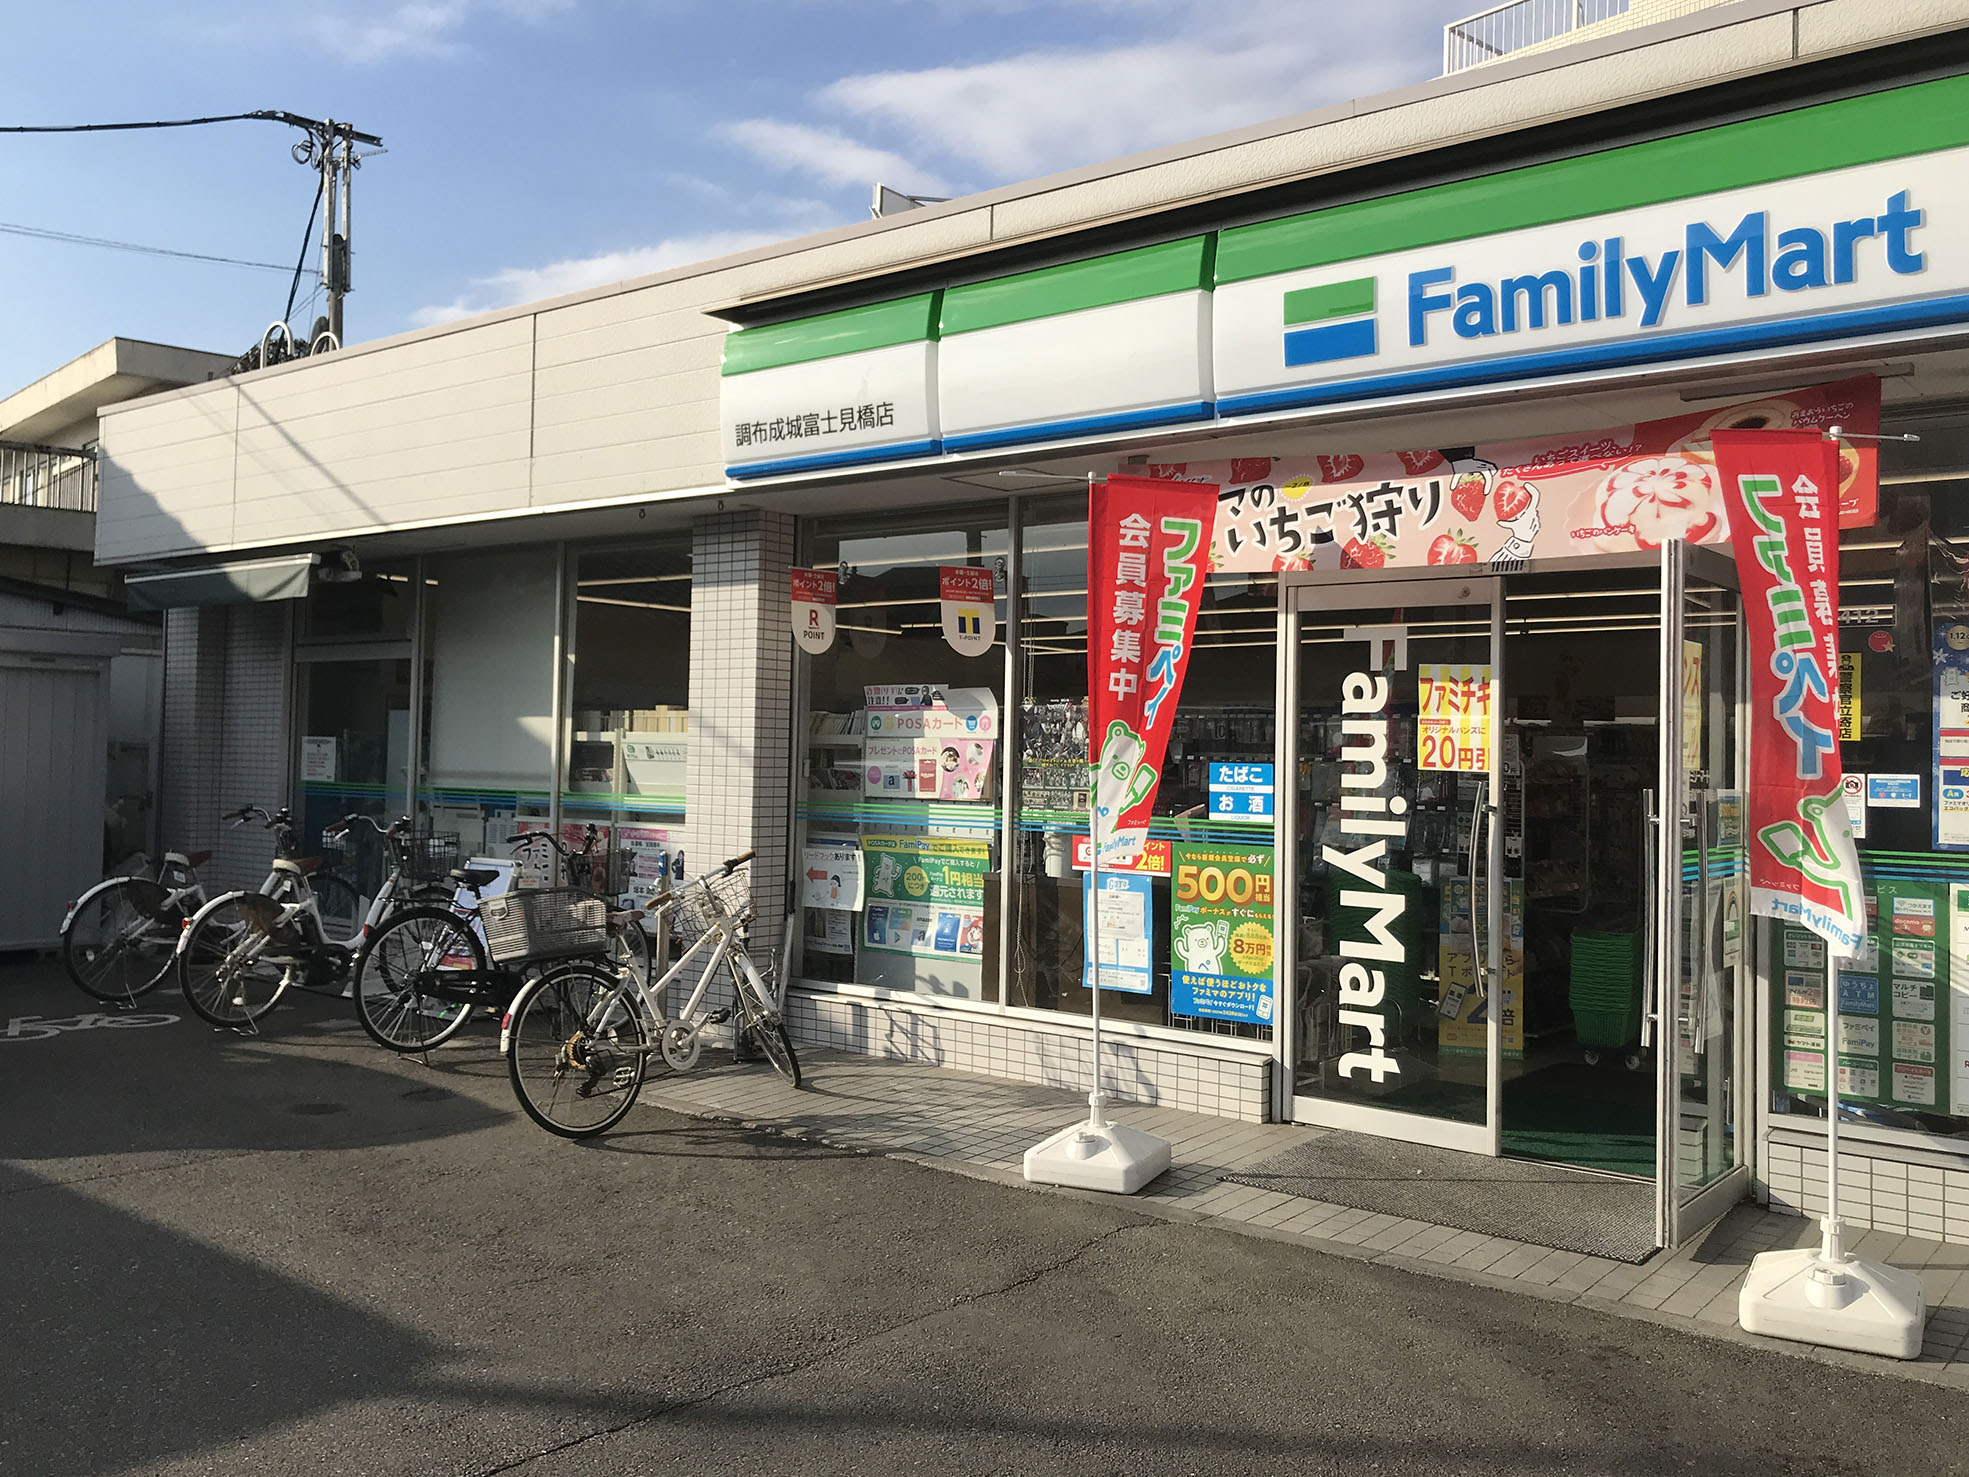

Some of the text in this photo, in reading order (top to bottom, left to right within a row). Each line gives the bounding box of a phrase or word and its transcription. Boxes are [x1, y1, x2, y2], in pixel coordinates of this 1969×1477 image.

[1408, 189, 1925, 347] FamilyMart
[735, 401, 894, 447] 調布成城富士見橋店
[1227, 480, 1442, 553] いちご狩り
[941, 576, 992, 592] ポイント2倍!
[1107, 512, 1152, 700] 会員募集中
[809, 609, 819, 627] R
[1144, 516, 1202, 731] ファミペイ
[803, 630, 825, 641] POINT
[1420, 675, 1490, 715] ファミチキ
[896, 717, 963, 730] POSAカード
[1218, 765, 1264, 783] たばこ
[1321, 626, 1408, 1084] FamilyMart
[930, 884, 984, 900] 還元されます
[1176, 864, 1271, 903] 500円
[1232, 938, 1266, 956] 8万円
[1191, 986, 1257, 1003] ファミマのアプリ!
[1893, 983, 1918, 991] マルチ
[1842, 1022, 1876, 1032] ファミペイ
[1842, 1037, 1876, 1049] FamiPay
